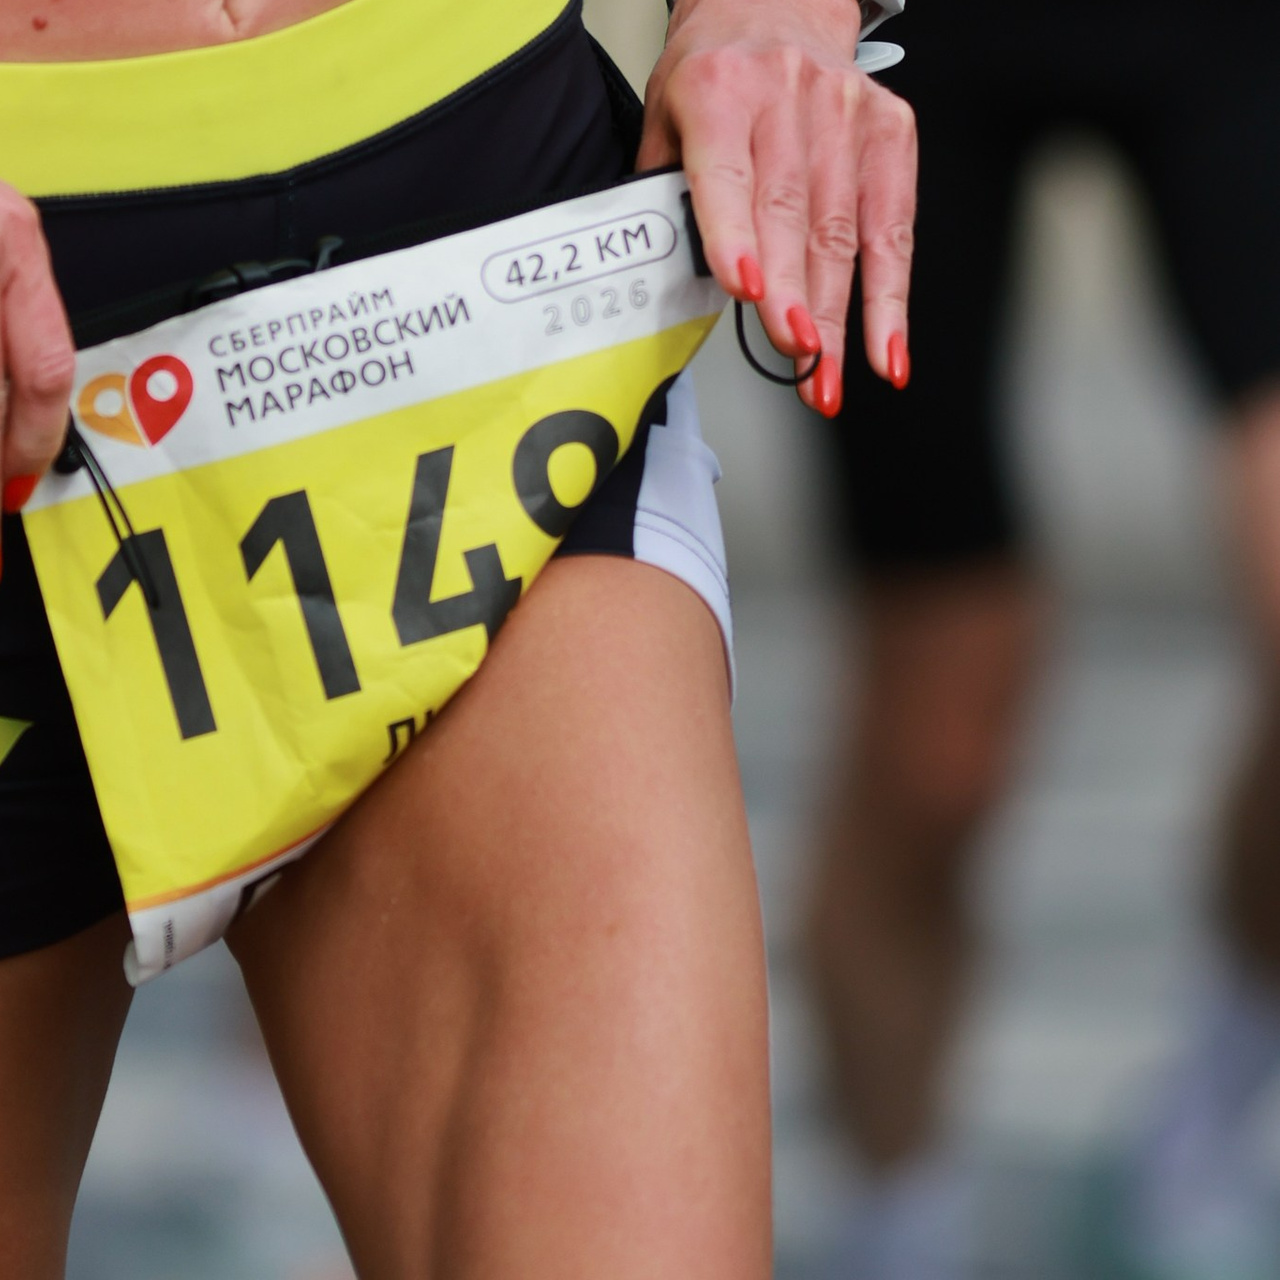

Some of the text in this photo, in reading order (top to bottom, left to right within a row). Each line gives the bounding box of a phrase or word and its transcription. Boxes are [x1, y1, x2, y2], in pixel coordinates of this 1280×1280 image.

[505, 223, 652, 286] 42,2 КМ
[208, 288, 395, 358] СБЕРПРАЙМ
[215, 293, 471, 392] МОСКОВСКИЙ
[542, 279, 651, 337] 2026
[224, 350, 415, 427] МАРАФОН
